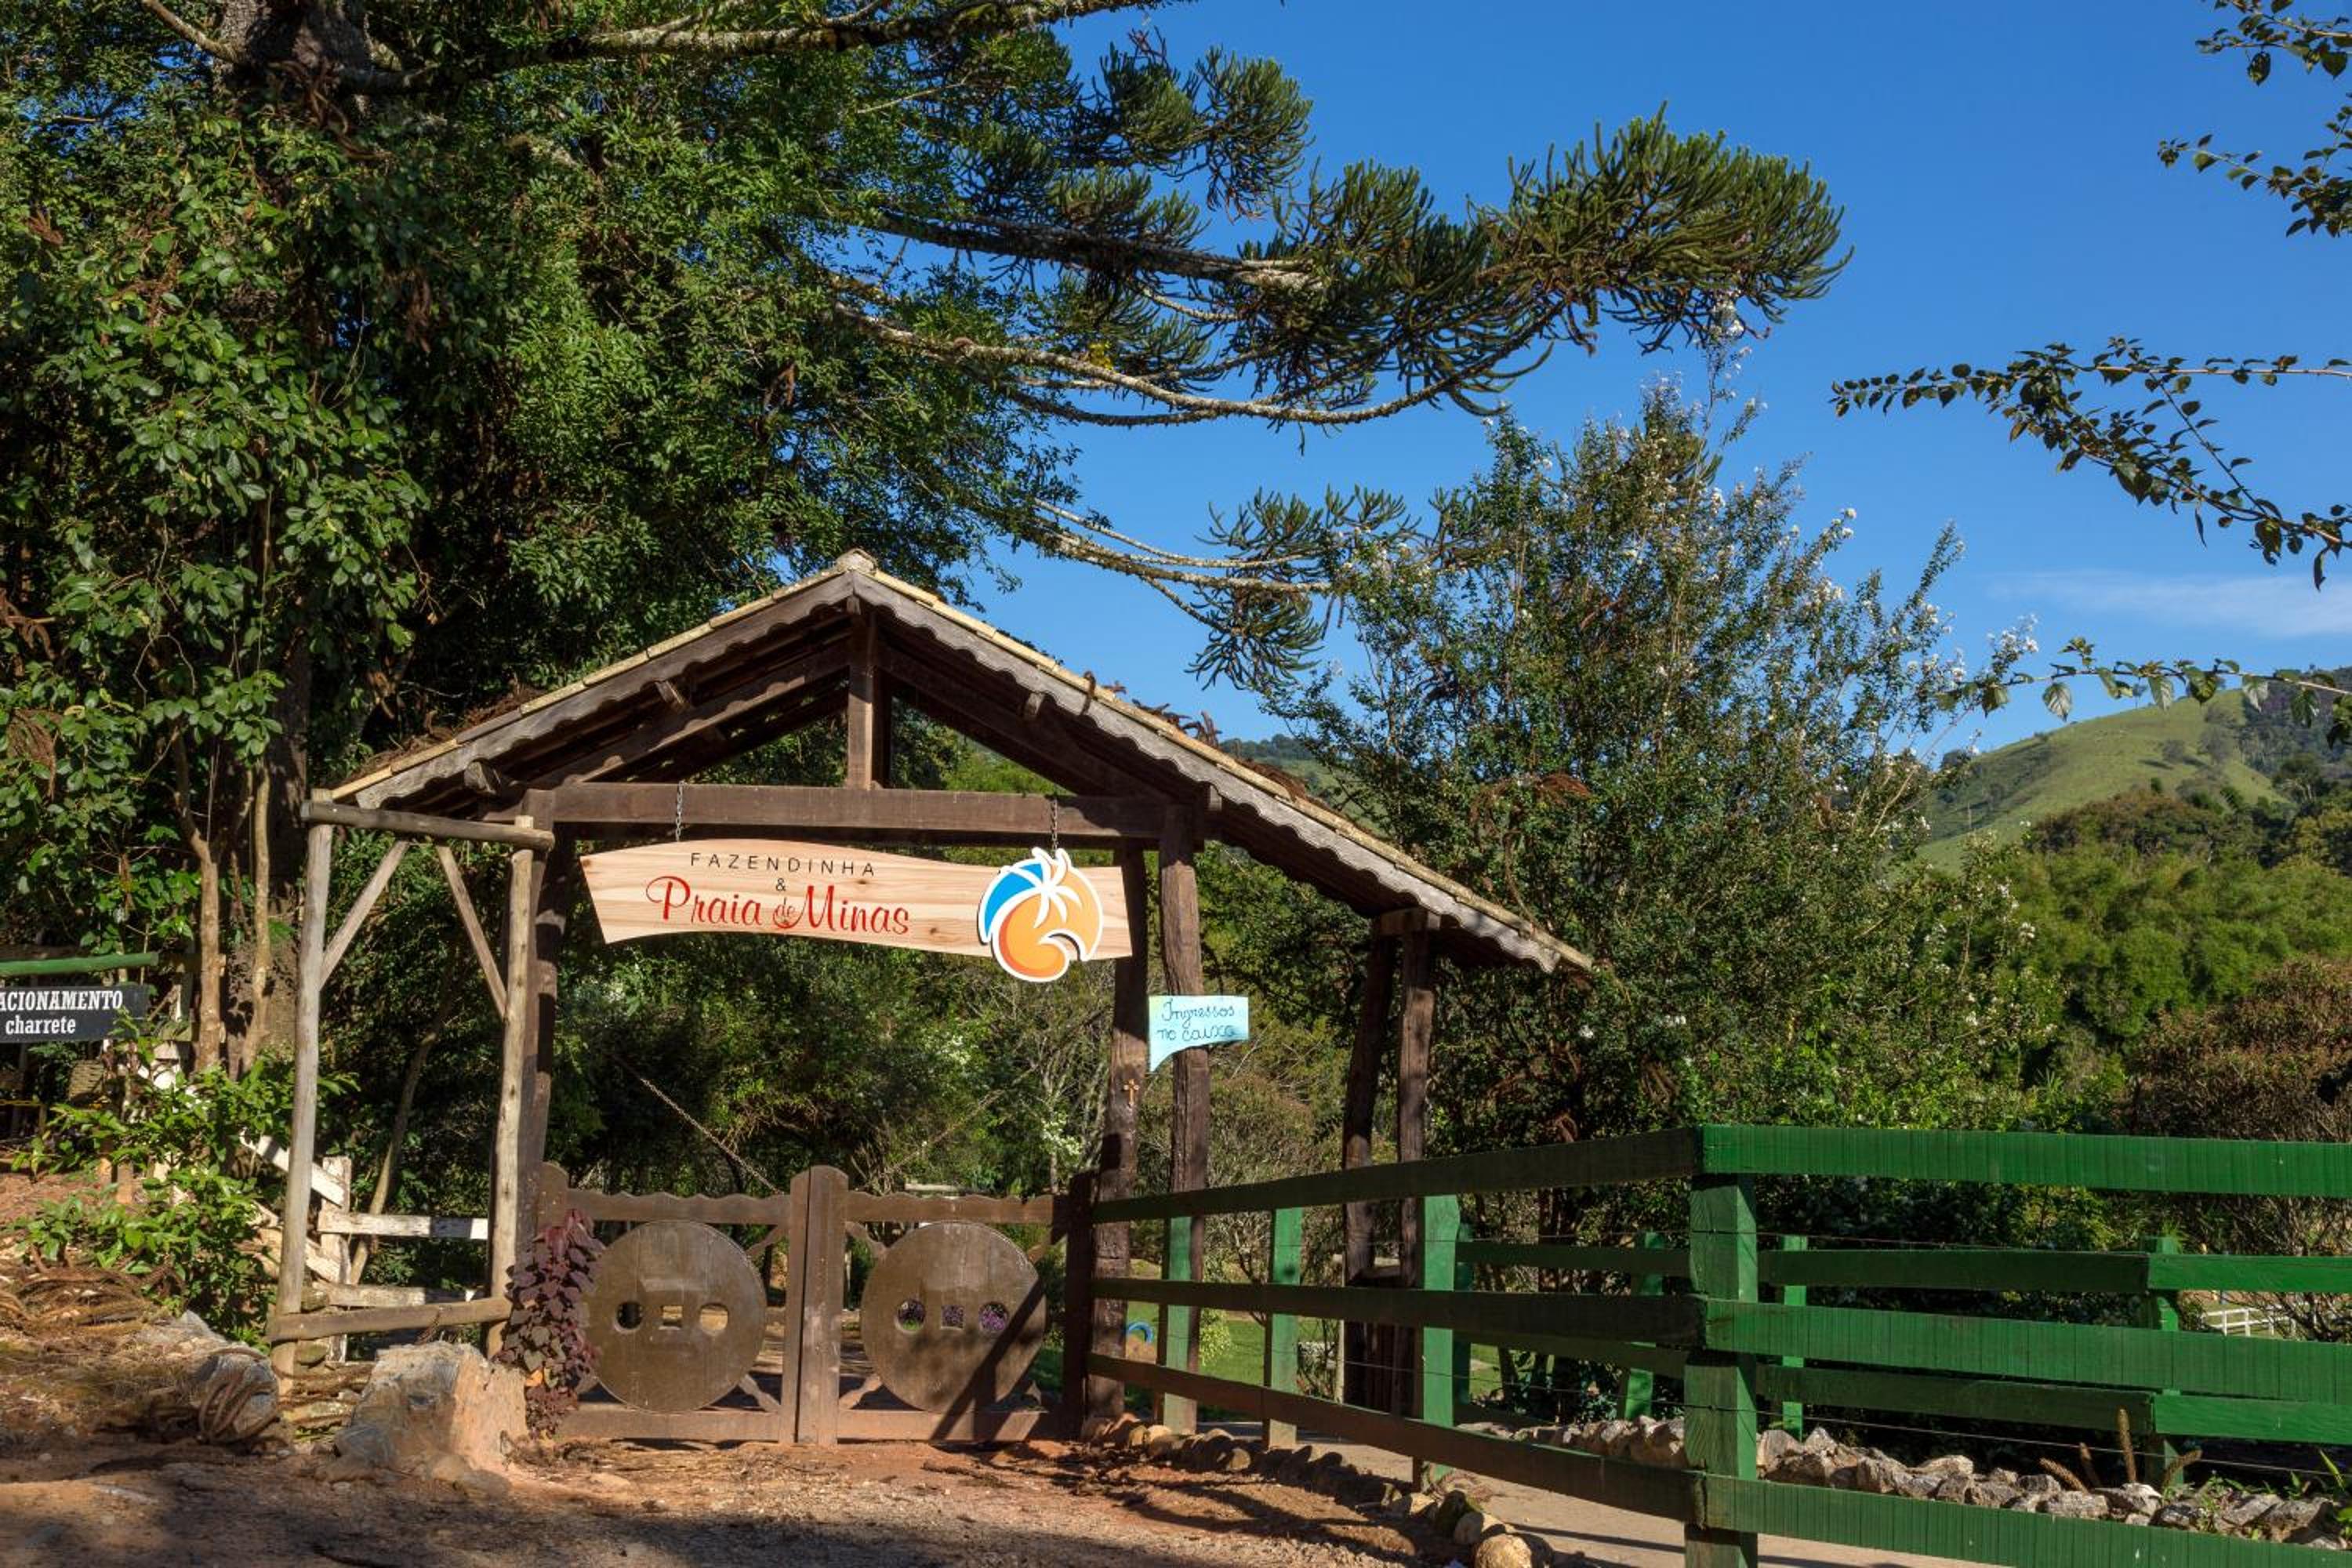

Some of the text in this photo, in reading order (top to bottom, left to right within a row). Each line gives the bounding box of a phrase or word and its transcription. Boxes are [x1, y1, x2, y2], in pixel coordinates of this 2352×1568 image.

[690, 852, 875, 877] FAZENDINHA
[775, 877, 787, 891] &
[645, 875, 763, 926] Praia
[773, 884, 909, 935] Minas
[5, 1014, 76, 1035] charrete
[1161, 997, 1236, 1029] Ingressos
[1156, 1028, 1177, 1041] no
